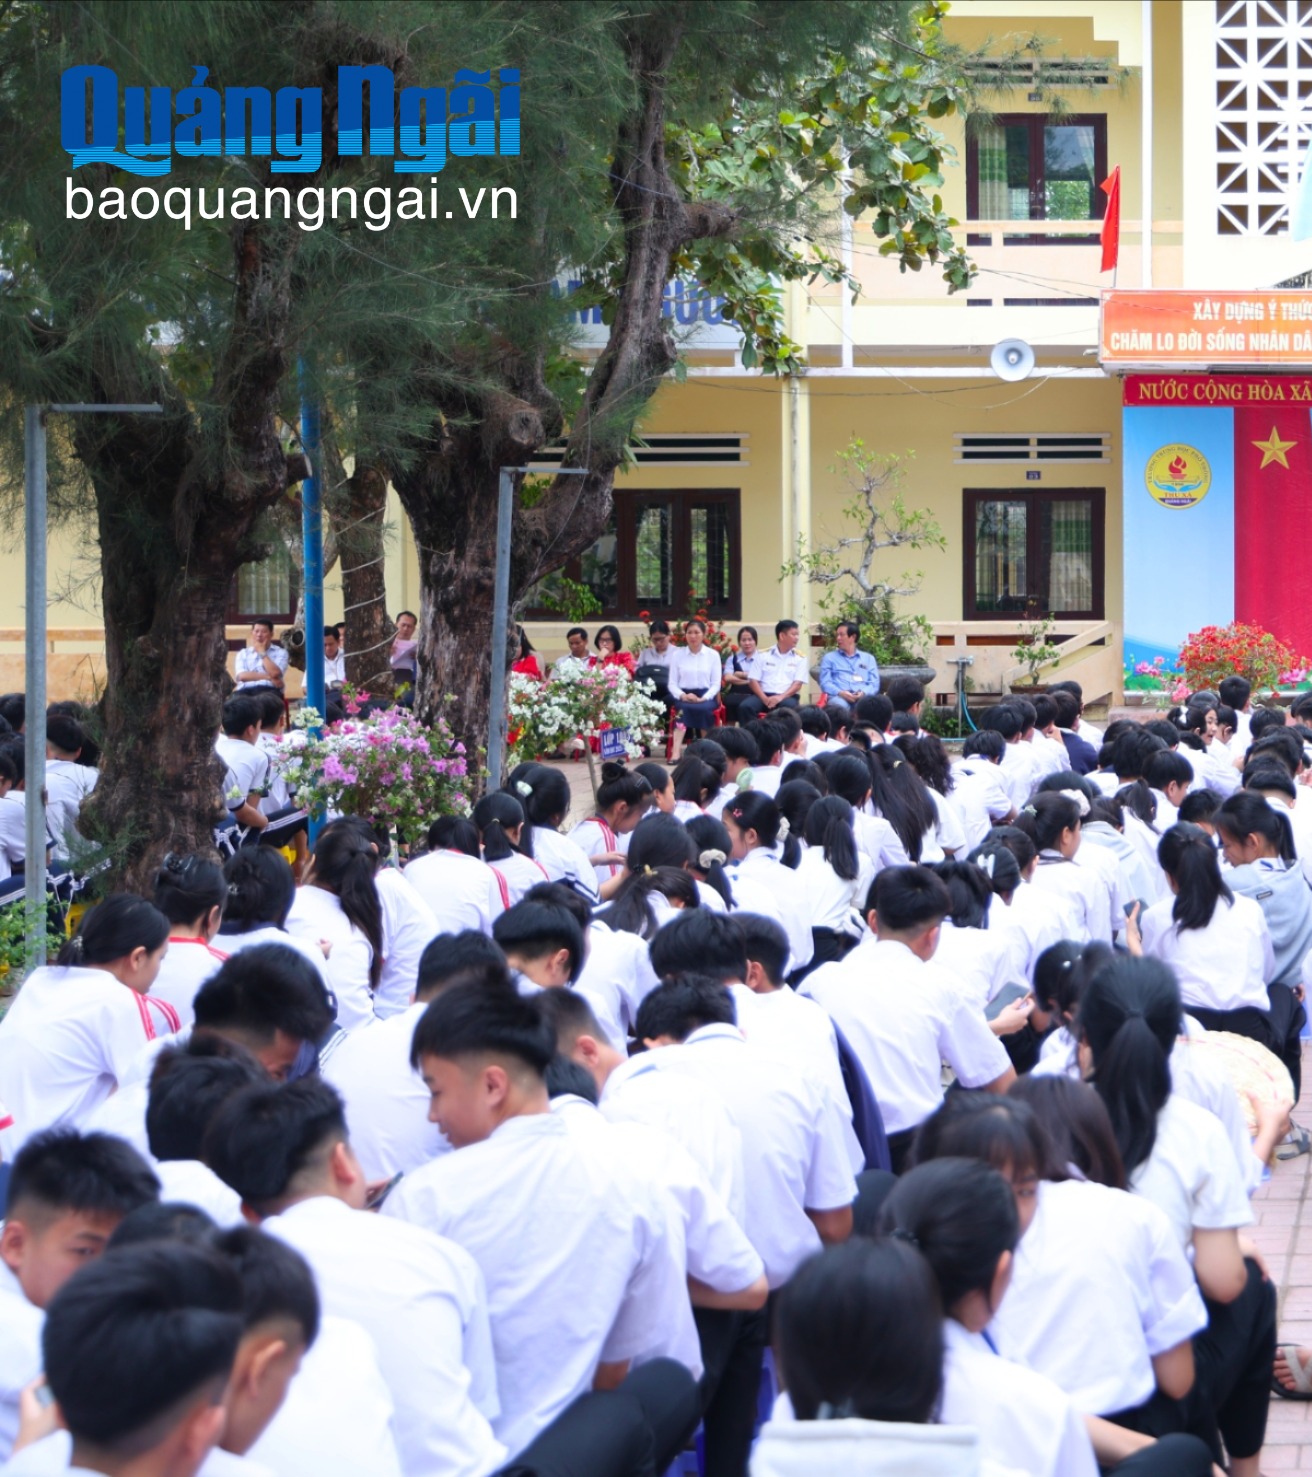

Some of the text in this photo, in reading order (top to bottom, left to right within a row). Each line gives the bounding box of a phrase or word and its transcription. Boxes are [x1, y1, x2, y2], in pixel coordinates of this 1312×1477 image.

[1193, 298, 1221, 321] XÂY
[1225, 301, 1263, 324] DỰNG
[1110, 329, 1152, 351] CHĂM
[1157, 332, 1174, 351] LO
[1178, 328, 1203, 351] ĐỜI
[1206, 326, 1245, 351] SỐNG
[1251, 328, 1290, 351] NHÂN
[1139, 379, 1188, 400] NƯỚC
[1193, 379, 1242, 404] CỘNG
[1248, 379, 1285, 401] HÒA
[1290, 381, 1312, 401] XÃ
